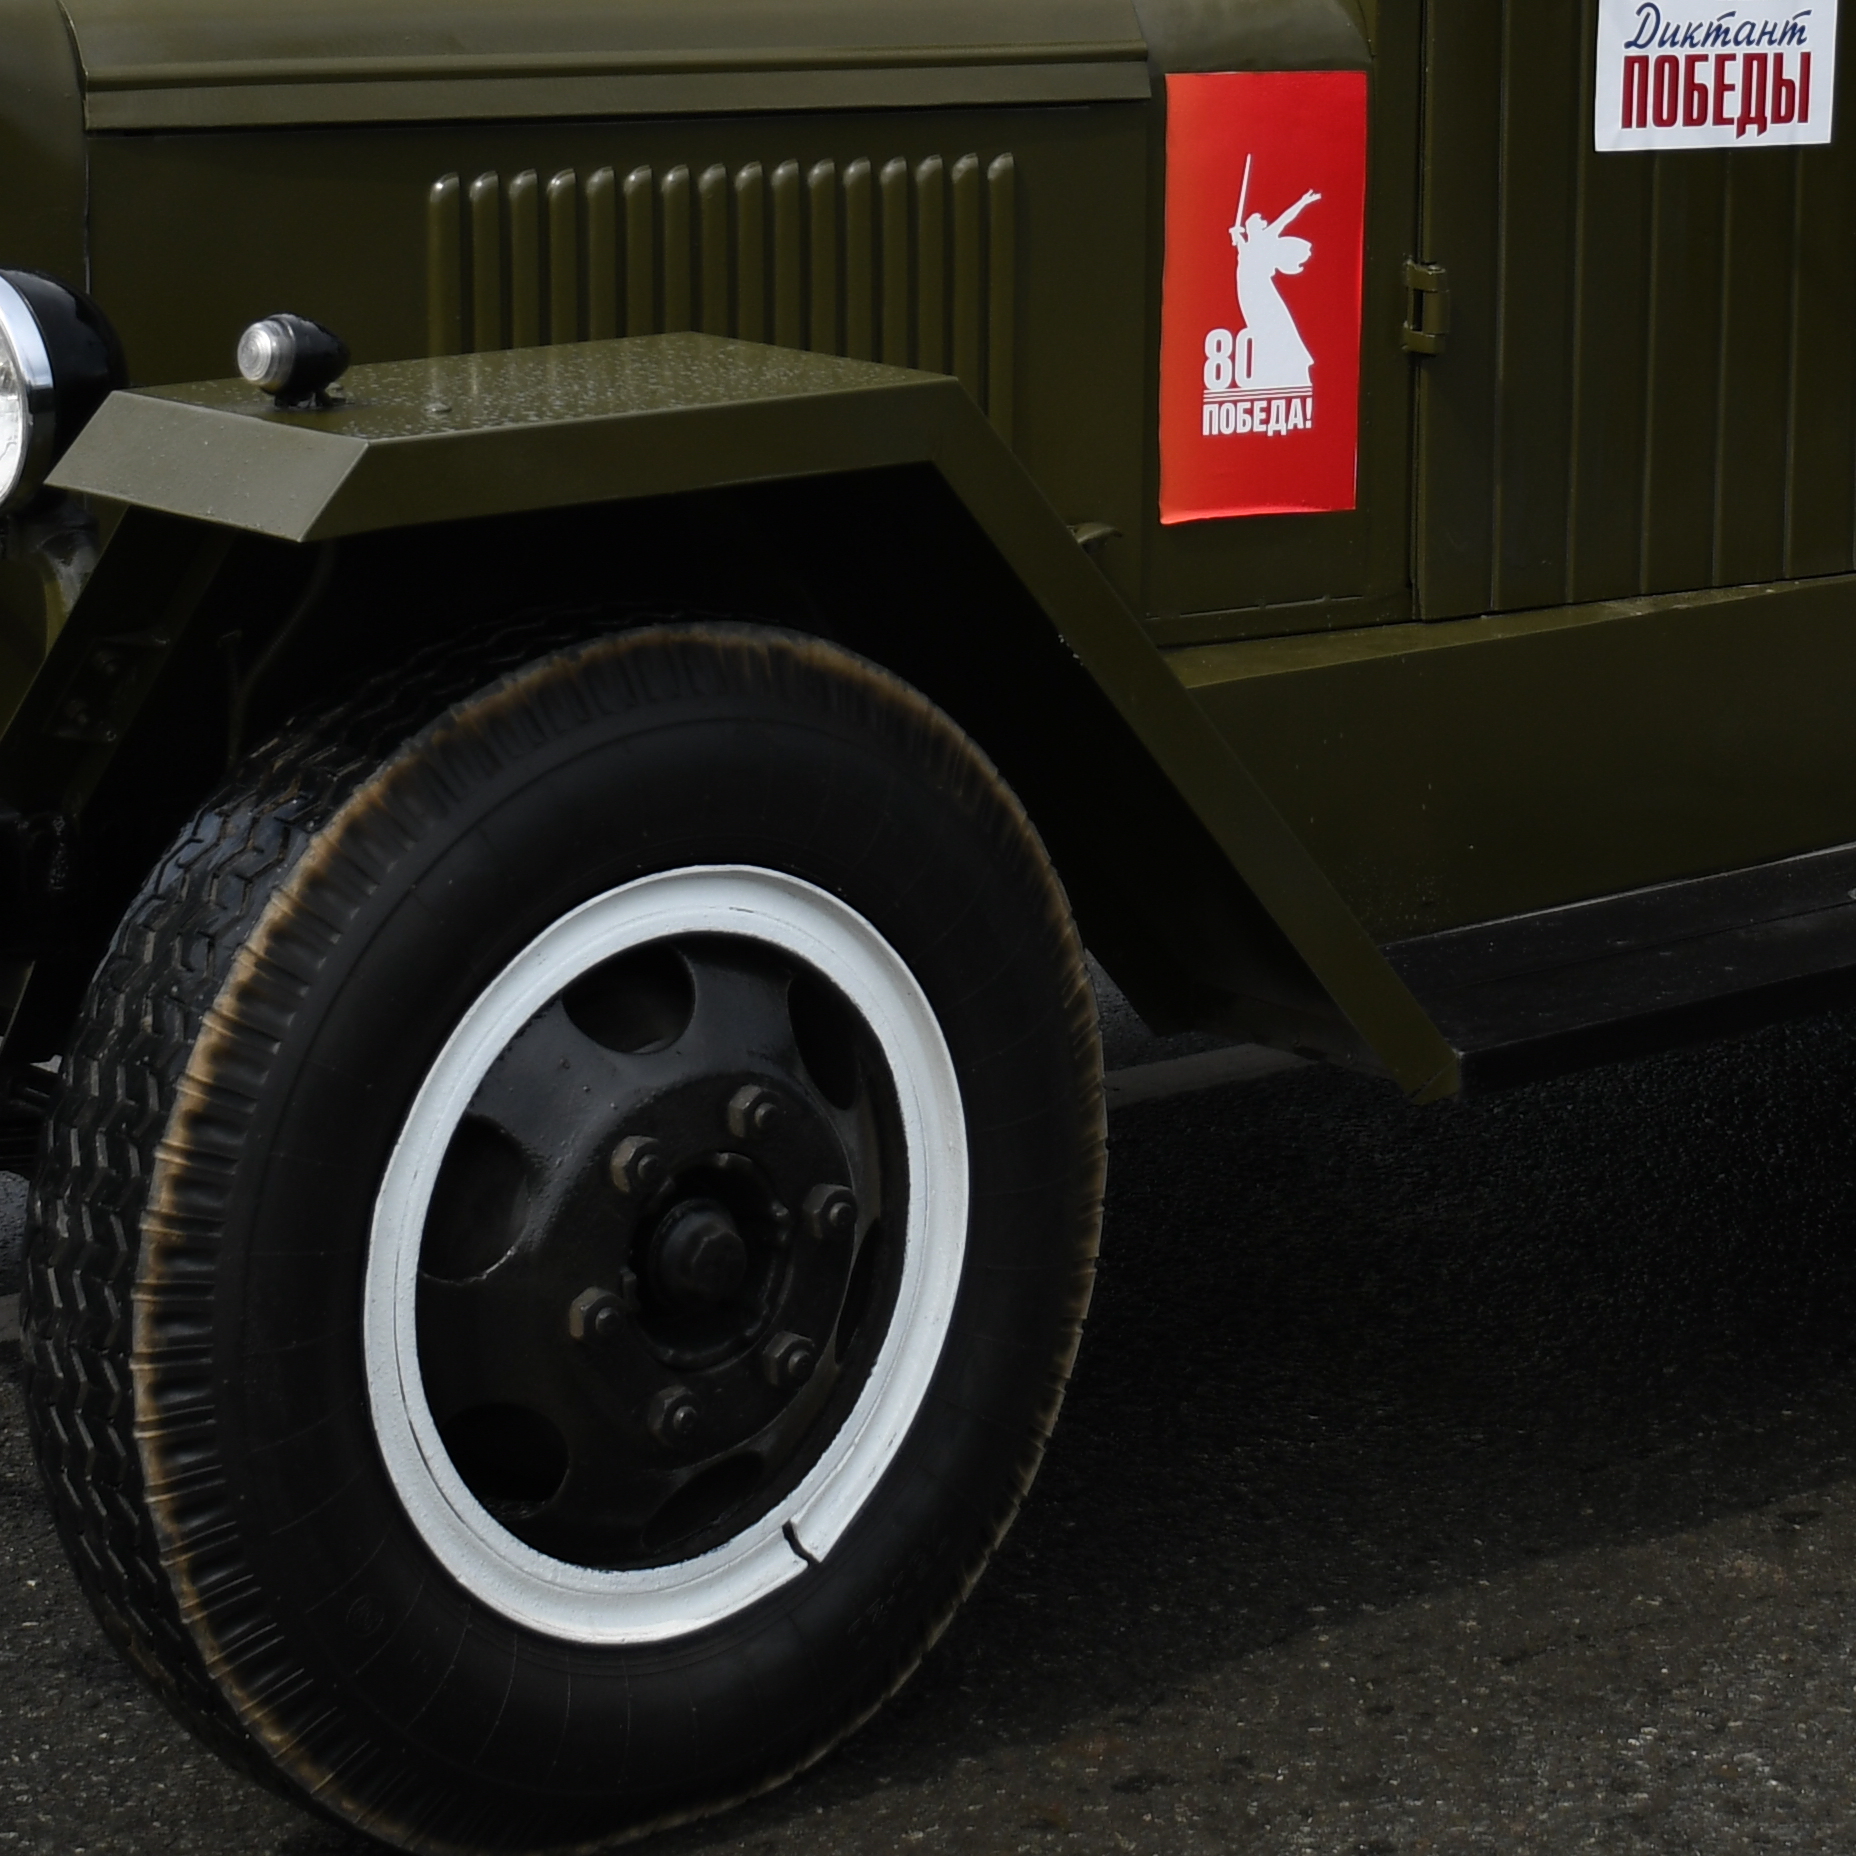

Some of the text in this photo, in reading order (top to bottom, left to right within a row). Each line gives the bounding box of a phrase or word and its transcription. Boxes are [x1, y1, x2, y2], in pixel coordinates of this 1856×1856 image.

[1624, 1, 1813, 50] Диктант
[1621, 51, 1812, 140] ПОБЕДЫ
[1204, 328, 1255, 390] 80
[1203, 397, 1313, 436] ПОБЕДА!
